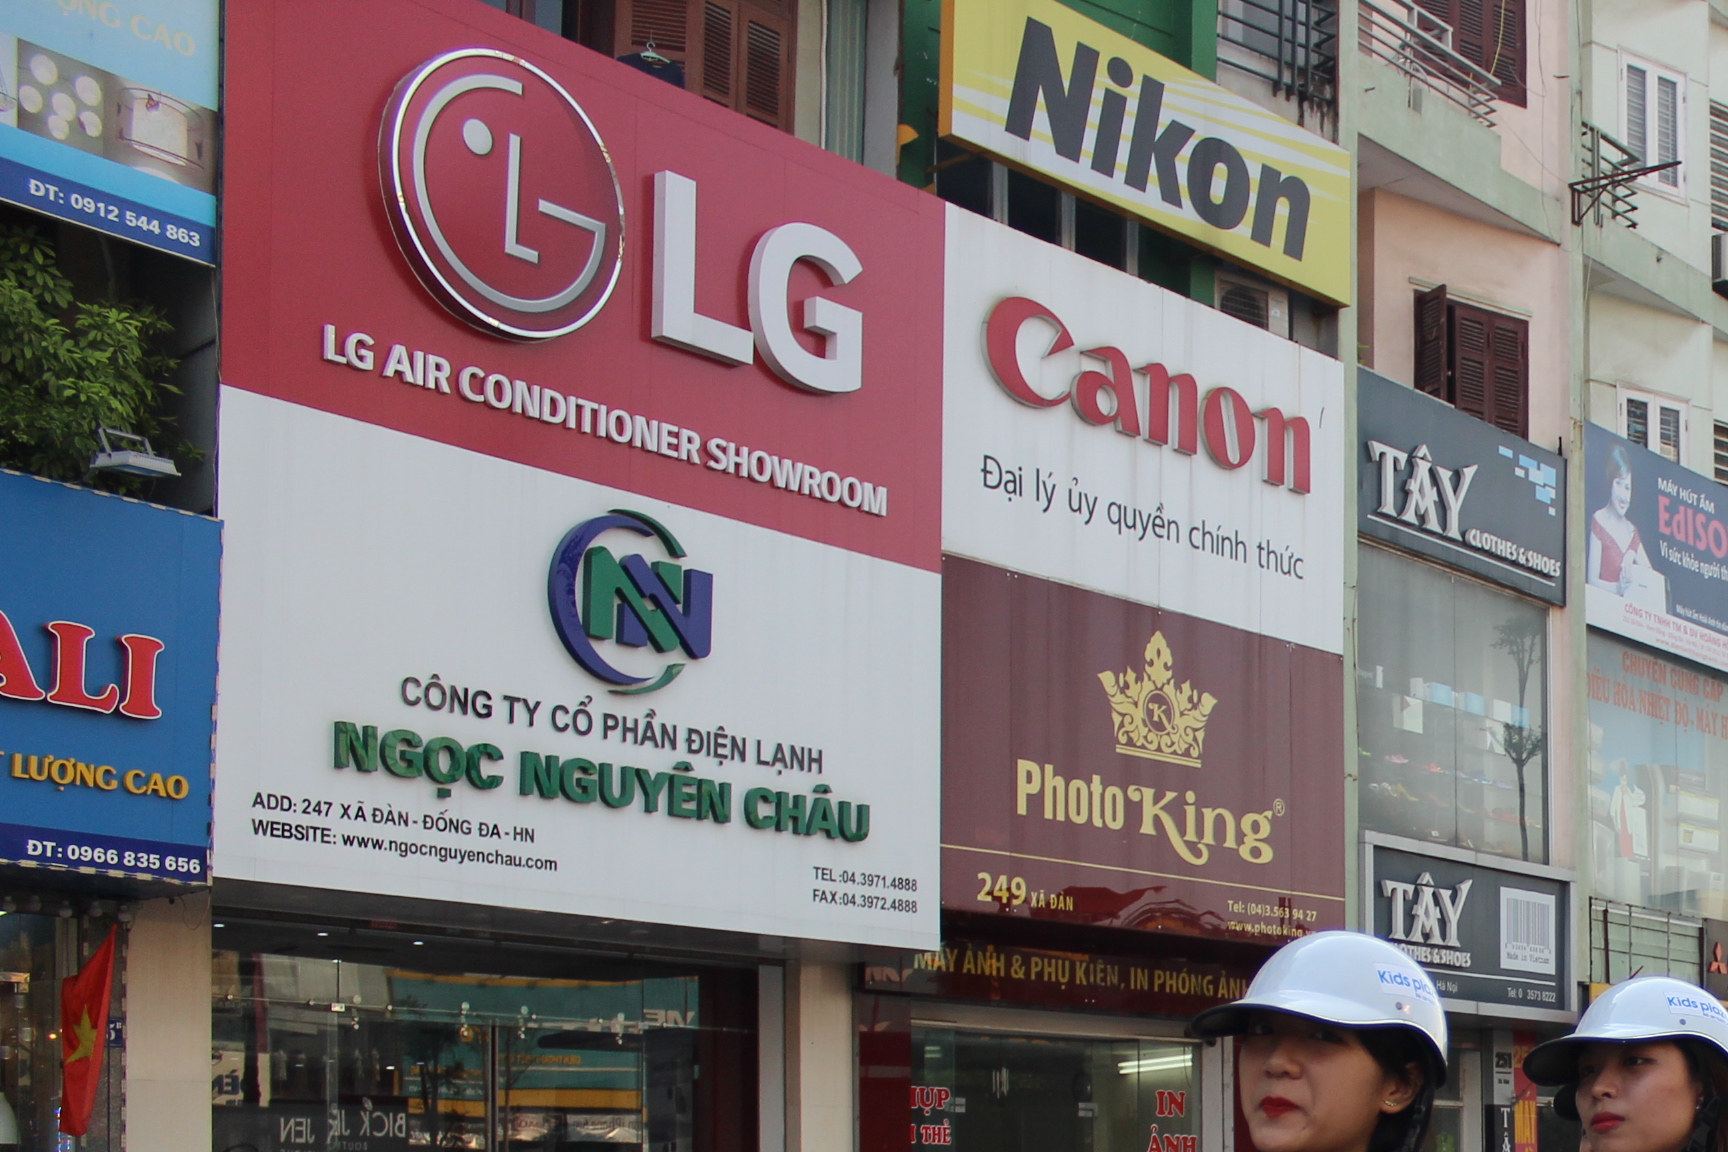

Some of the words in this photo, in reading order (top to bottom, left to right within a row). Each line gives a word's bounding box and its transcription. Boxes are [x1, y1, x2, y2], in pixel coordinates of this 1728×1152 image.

[130, 14, 195, 56] CAO
[1005, 16, 1311, 262] Nikon
[29, 177, 64, 204] ĐT:
[70, 192, 119, 223] 0912
[125, 213, 160, 236] 544
[166, 224, 201, 247] 863
[651, 170, 863, 394] LG
[323, 323, 375, 371] LG
[382, 344, 451, 394] AIR
[459, 366, 701, 465] CONDITIONER
[706, 437, 889, 516] SHOWROOM
[981, 296, 1311, 495] Canon
[981, 455, 1022, 502] Đại
[1035, 467, 1056, 513] lý
[1068, 477, 1098, 525] ủy
[1107, 503, 1180, 544] quyền
[1188, 520, 1247, 563] chính
[1256, 540, 1304, 580] thức
[1367, 440, 1478, 541] TÂY
[401, 674, 493, 719] CÔNG
[503, 696, 541, 727] TY
[551, 696, 593, 736] CỔ
[603, 709, 678, 752] PHẦN
[686, 726, 747, 766] ĐIỆN
[755, 739, 824, 775] LẠNH
[11, 752, 118, 791] LƯỢNG
[124, 769, 189, 800] CAO
[334, 720, 504, 798] NGỌC
[519, 760, 732, 824] NGUYÊN
[744, 784, 870, 842] CHÂU
[252, 792, 297, 814] ADD:
[301, 798, 333, 818] 247
[371, 804, 409, 827] ĐÀN
[422, 810, 472, 836] ĐỐNG
[478, 822, 502, 840] ĐA
[513, 826, 535, 844] HN
[27, 839, 63, 858] ĐT:
[67, 844, 118, 865] 0966
[123, 851, 160, 870] 835
[165, 856, 201, 875] 656
[252, 819, 338, 846] WEBSITE:
[342, 833, 558, 873] www.ngocnguyenchau.com
[977, 872, 1027, 906] 249
[1030, 889, 1046, 908] XÃ
[1049, 888, 1074, 912] ĐÀN
[1227, 900, 1245, 914] Tel:
[1292, 908, 1304, 920] 94
[1306, 910, 1317, 922] 27
[1381, 872, 1473, 947] TÂY
[1010, 957, 1026, 980] &
[1130, 966, 1149, 990] IN
[1377, 969, 1410, 987] Kids
[1667, 996, 1698, 1008] Kids
[1156, 1090, 1186, 1117] IN
